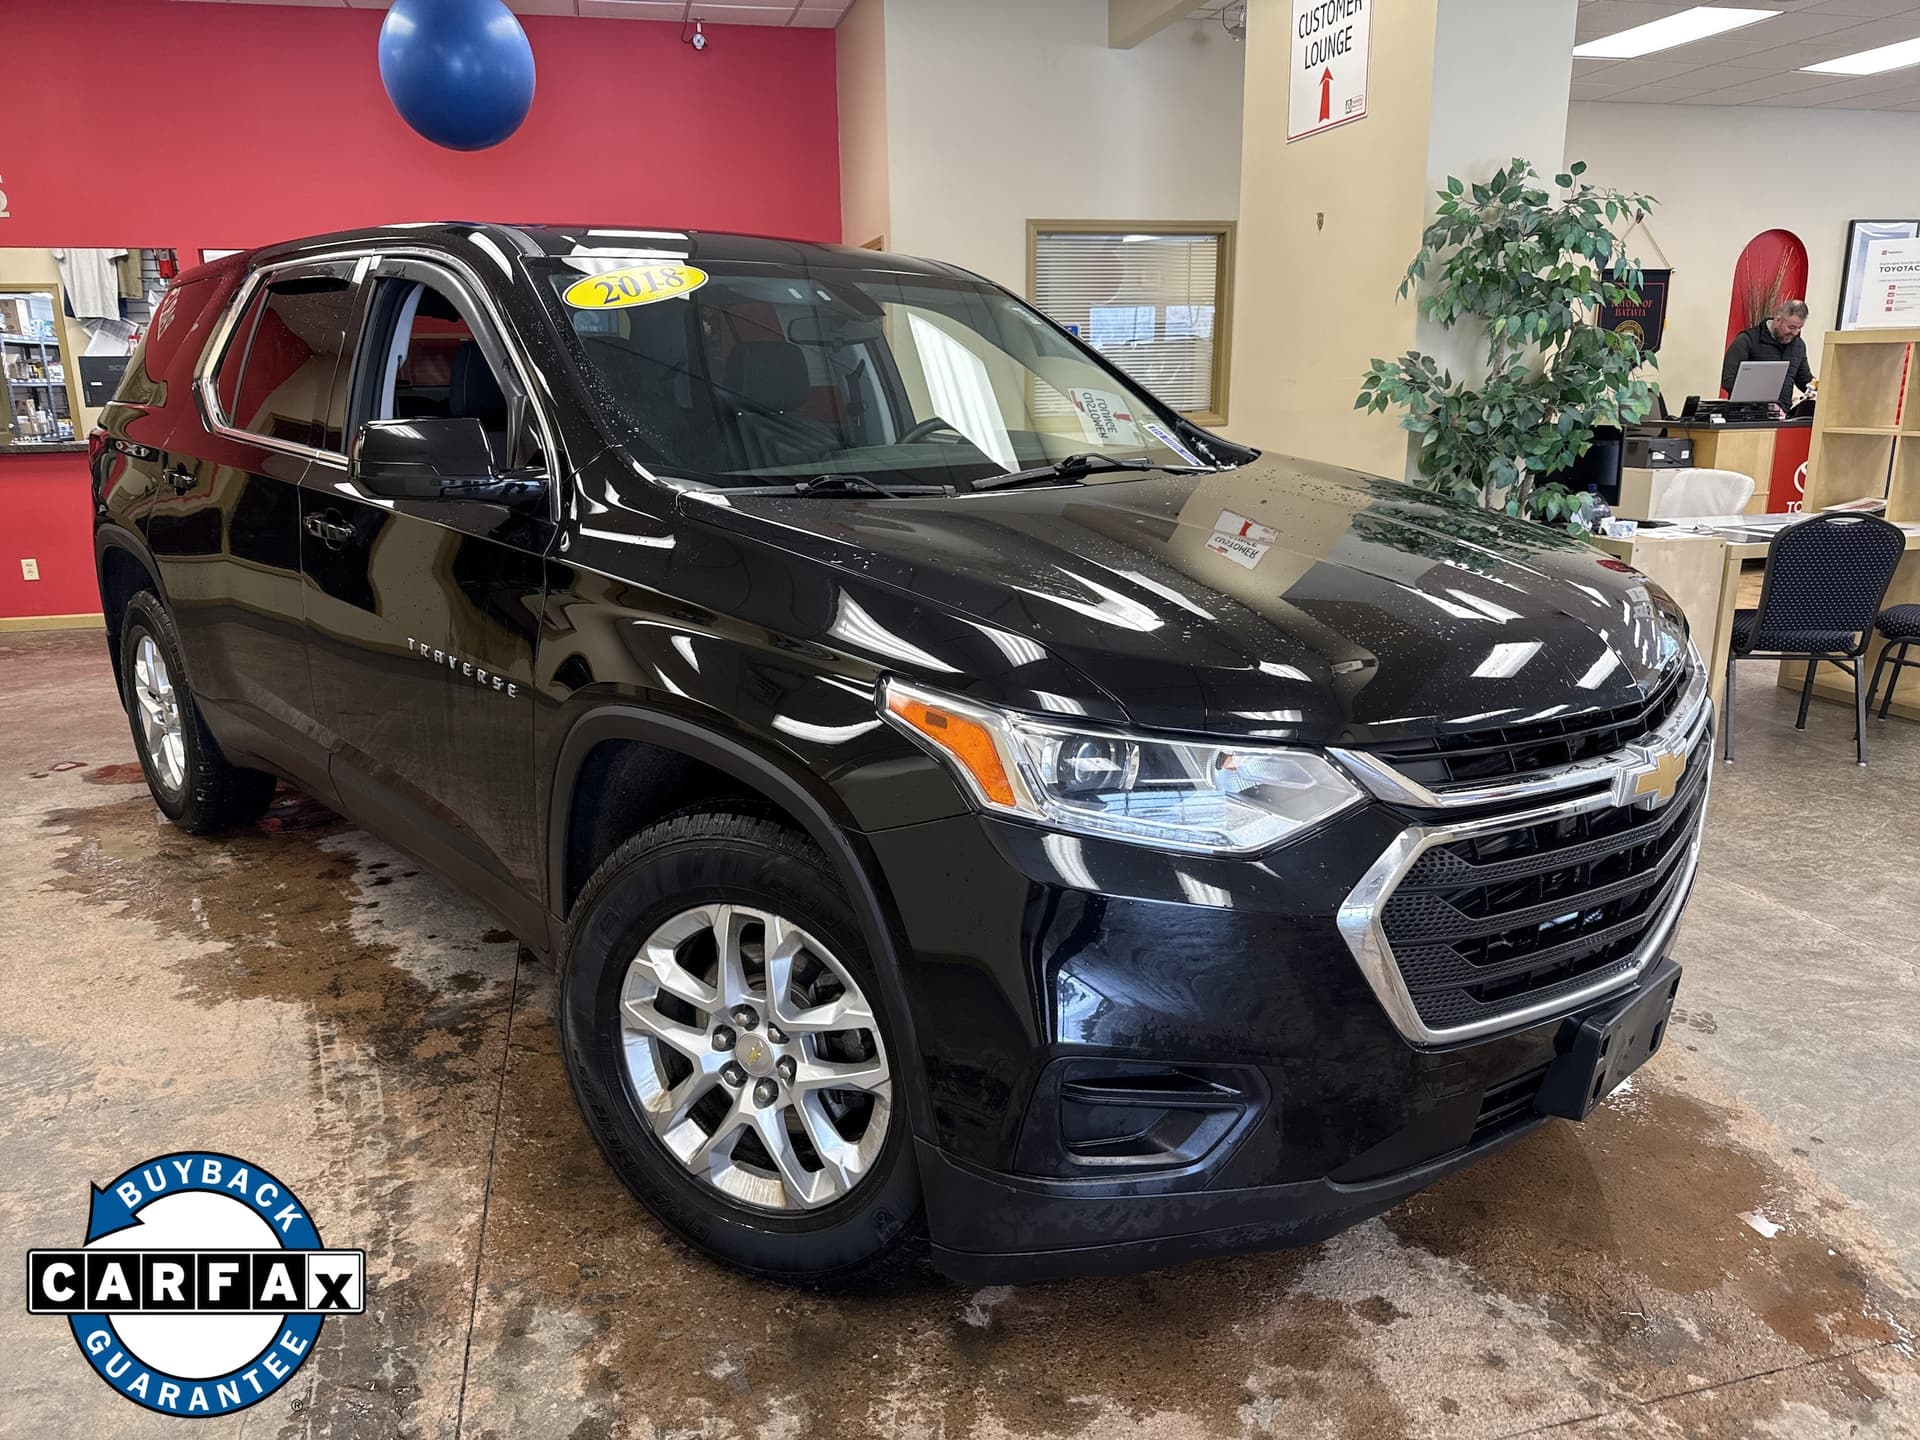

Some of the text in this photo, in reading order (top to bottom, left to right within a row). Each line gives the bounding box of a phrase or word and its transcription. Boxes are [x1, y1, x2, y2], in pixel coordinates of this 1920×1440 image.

[1298, 0, 1362, 39] CUSTOMER
[1304, 25, 1353, 70] LOUNGE
[594, 268, 685, 305] 2018
[1615, 308, 1646, 317] BATAVIA
[407, 637, 519, 698] TRAVERSE
